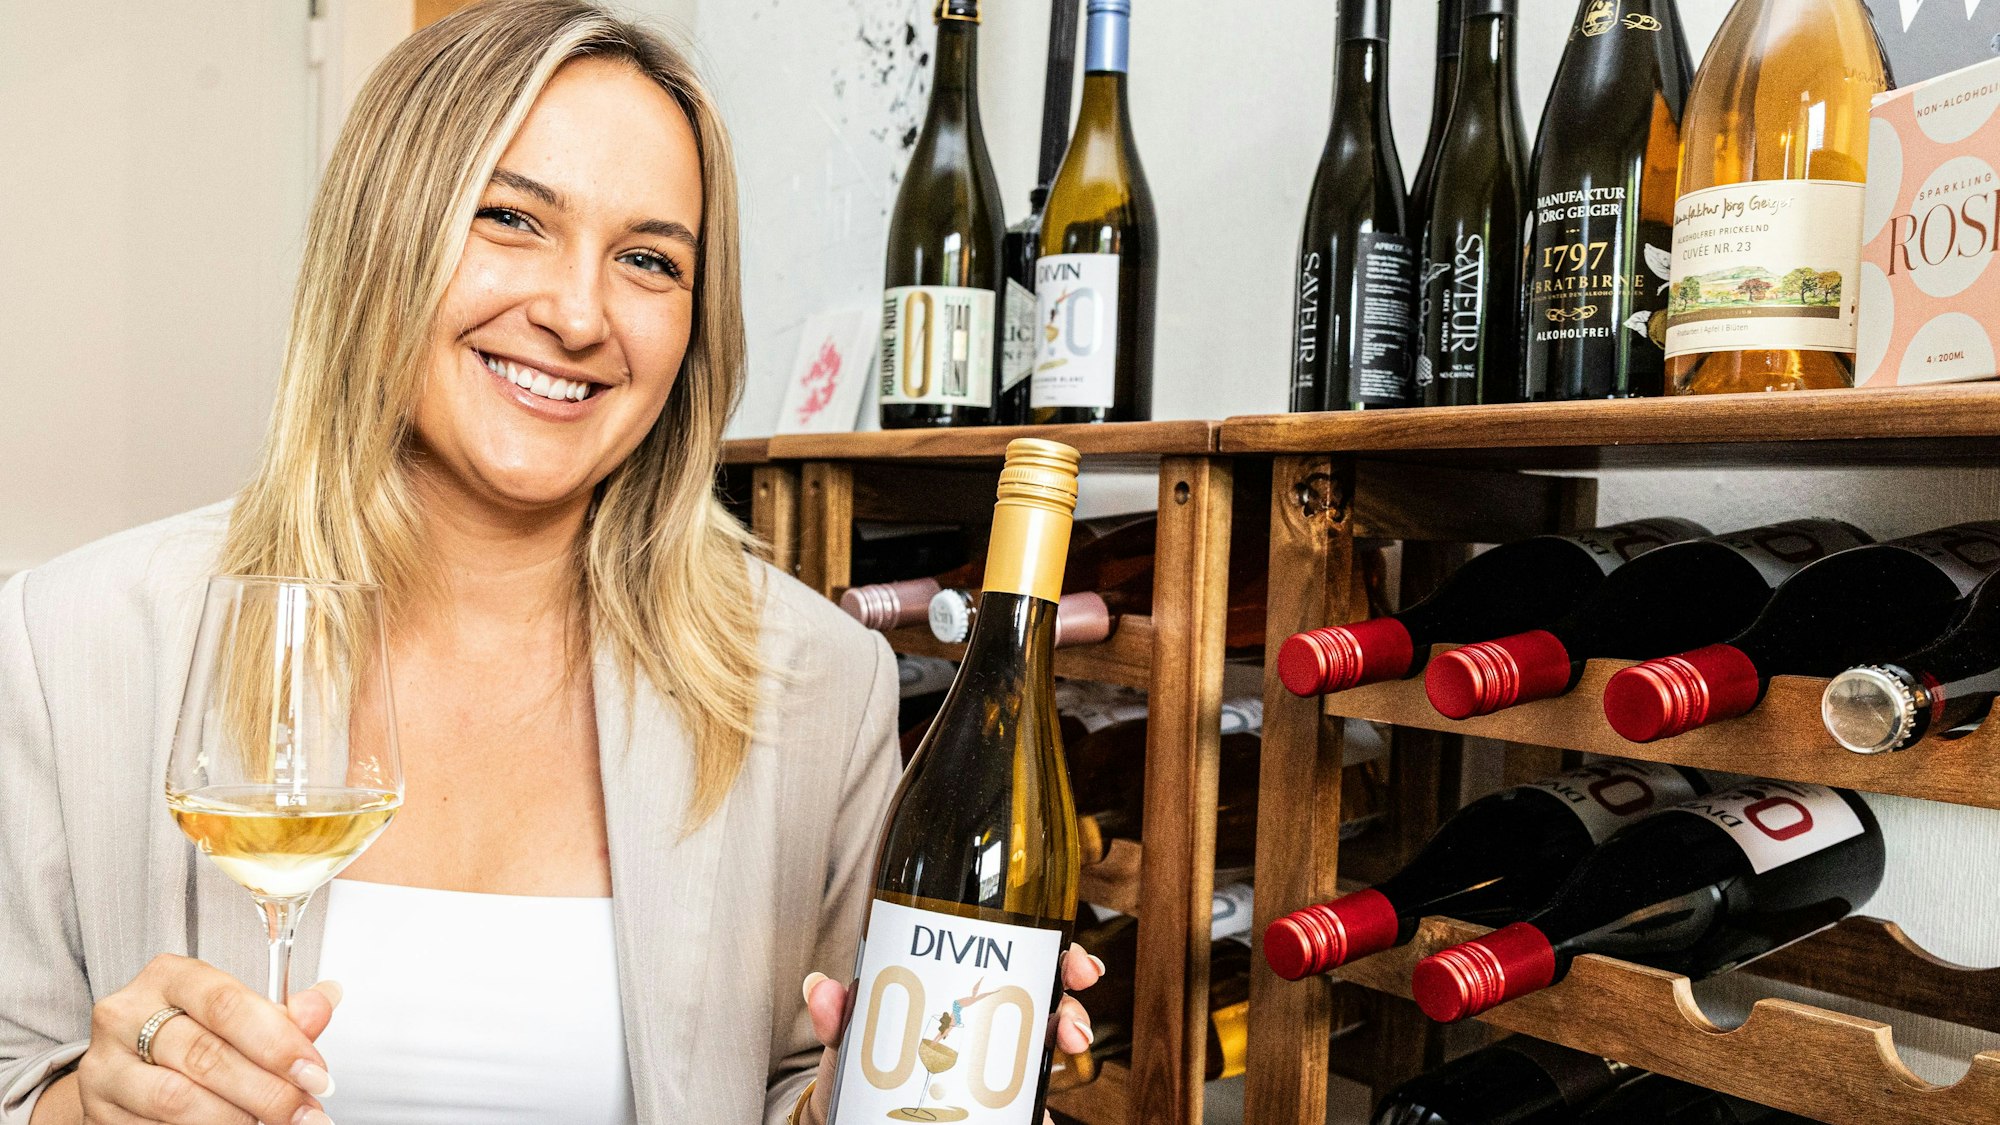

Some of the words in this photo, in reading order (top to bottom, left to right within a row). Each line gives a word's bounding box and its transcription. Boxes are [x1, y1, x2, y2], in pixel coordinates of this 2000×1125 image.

[1916, 82, 2000, 119] NON-ALCOHOLI
[1919, 172, 1993, 201] SPARKLING
[1537, 187, 1626, 209] MANUFAKTUR
[1537, 206, 1565, 226] JÖRG
[1567, 203, 1620, 219] GEIGER
[1719, 224, 1769, 236] PRICKELND
[1543, 241, 1608, 273] 1797
[1683, 243, 1709, 260] CUVÉE
[1736, 241, 1751, 252] 23
[1536, 327, 1609, 342] ALKOHOLFREI
[1938, 351, 1965, 363] 200ML
[910, 924, 1013, 972] DIVIN
